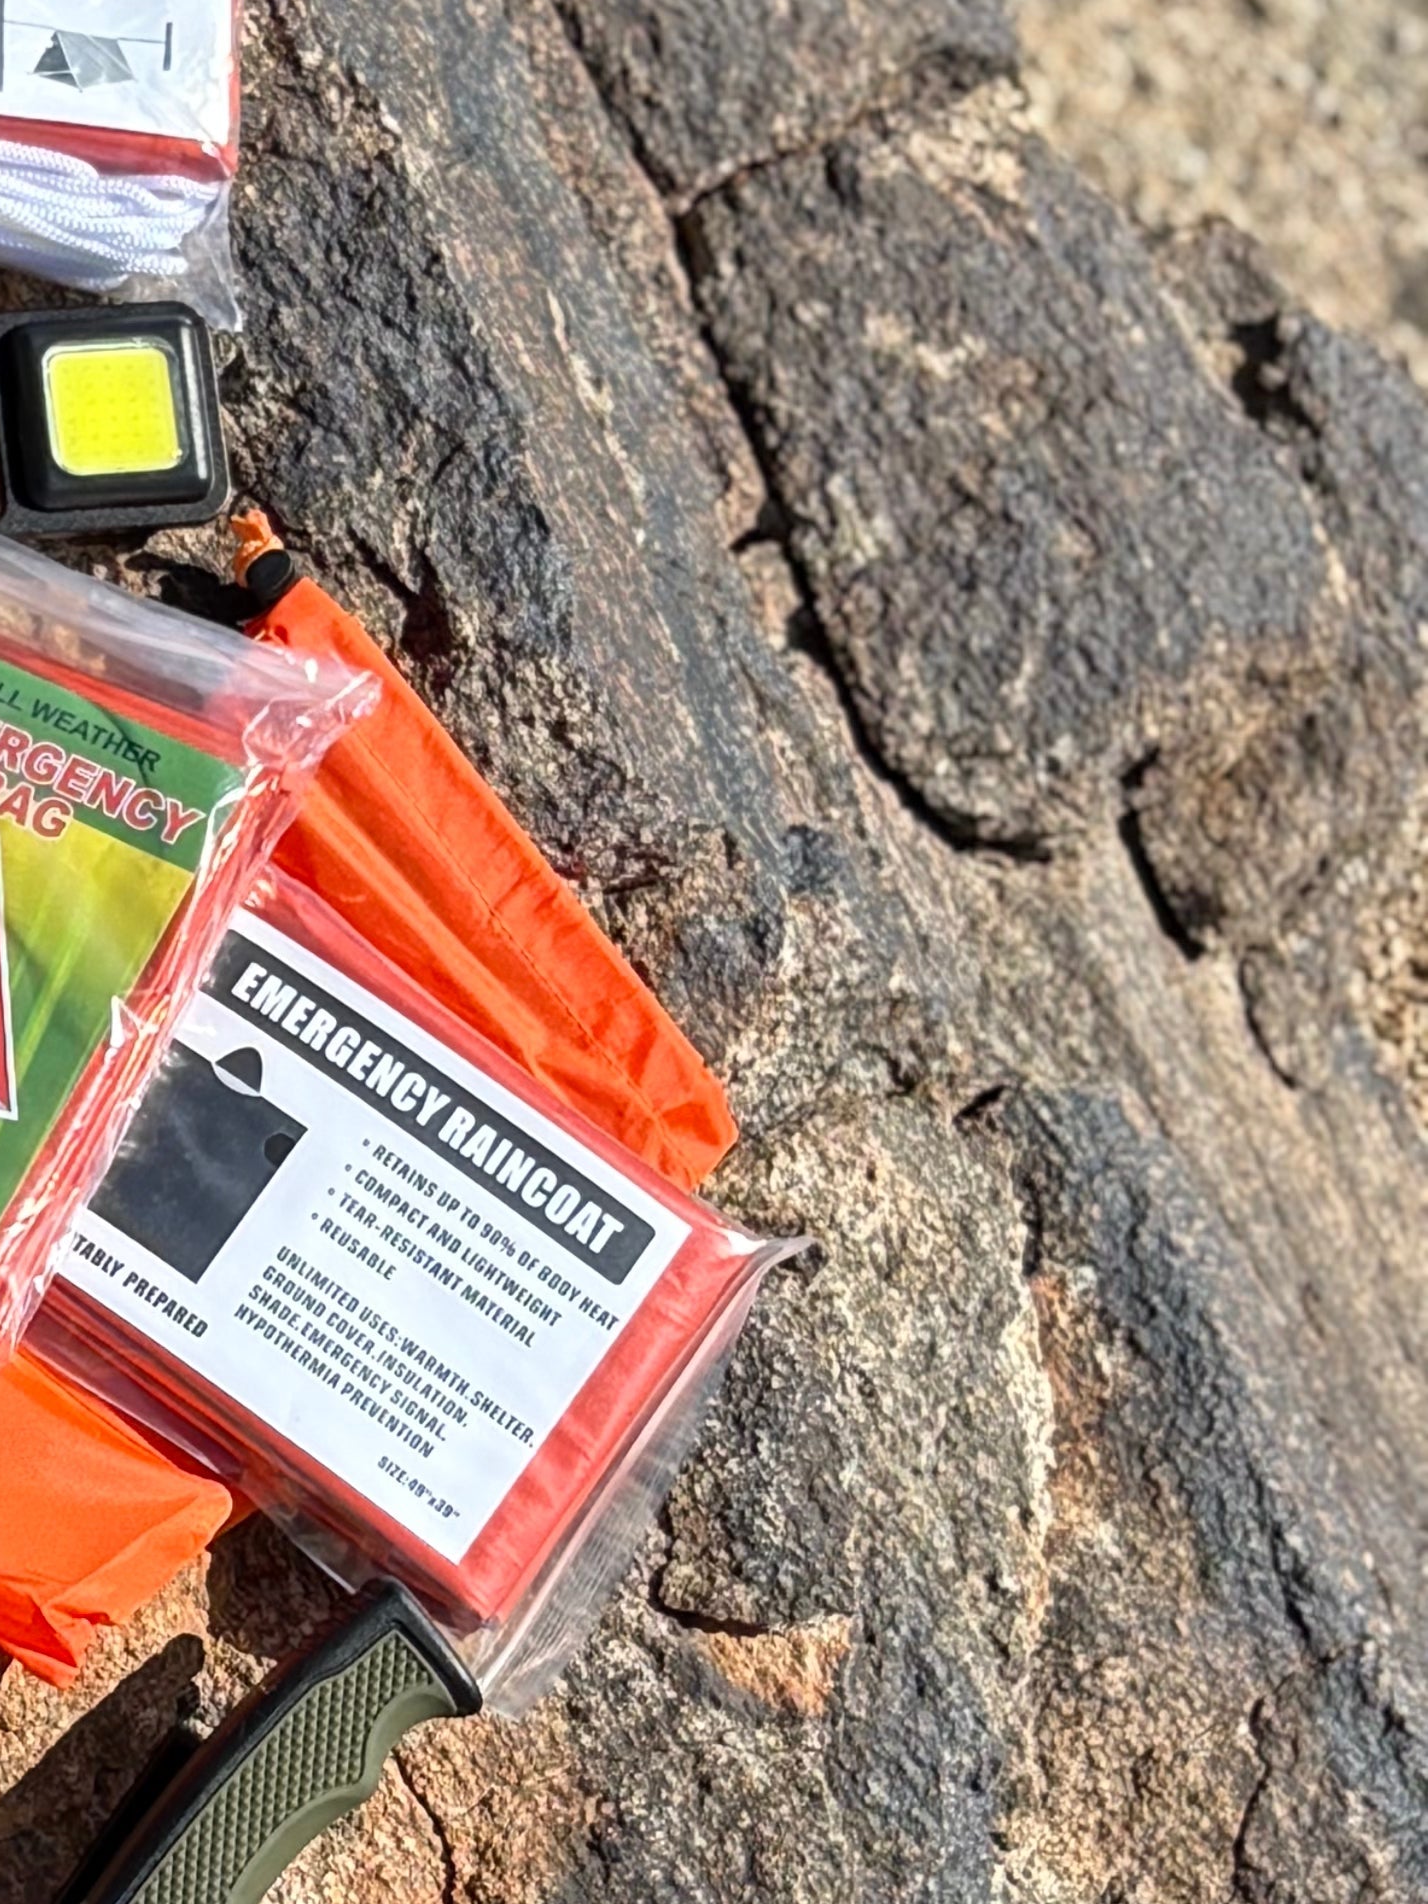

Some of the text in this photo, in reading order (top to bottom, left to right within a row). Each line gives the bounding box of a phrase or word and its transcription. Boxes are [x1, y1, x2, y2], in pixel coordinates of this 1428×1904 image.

[231, 961, 626, 1255] EMERGENCY RAINCOAT
[72, 1234, 208, 1337] TABLY PREPARED
[262, 1265, 326, 1317] GROUND
[276, 1246, 359, 1312] UNLIMITED
[319, 1217, 396, 1280] REUSABLE
[339, 1192, 535, 1348] TEAR-RESISTANT MATERIAL
[354, 1169, 562, 1327] COMPACT AND LIGHTWEIGHT
[372, 1144, 619, 1331] RETAINS UP TO 90% OF BODY HEAT
[233, 1303, 434, 1458] HYPOTHERMIA PREVENTION
